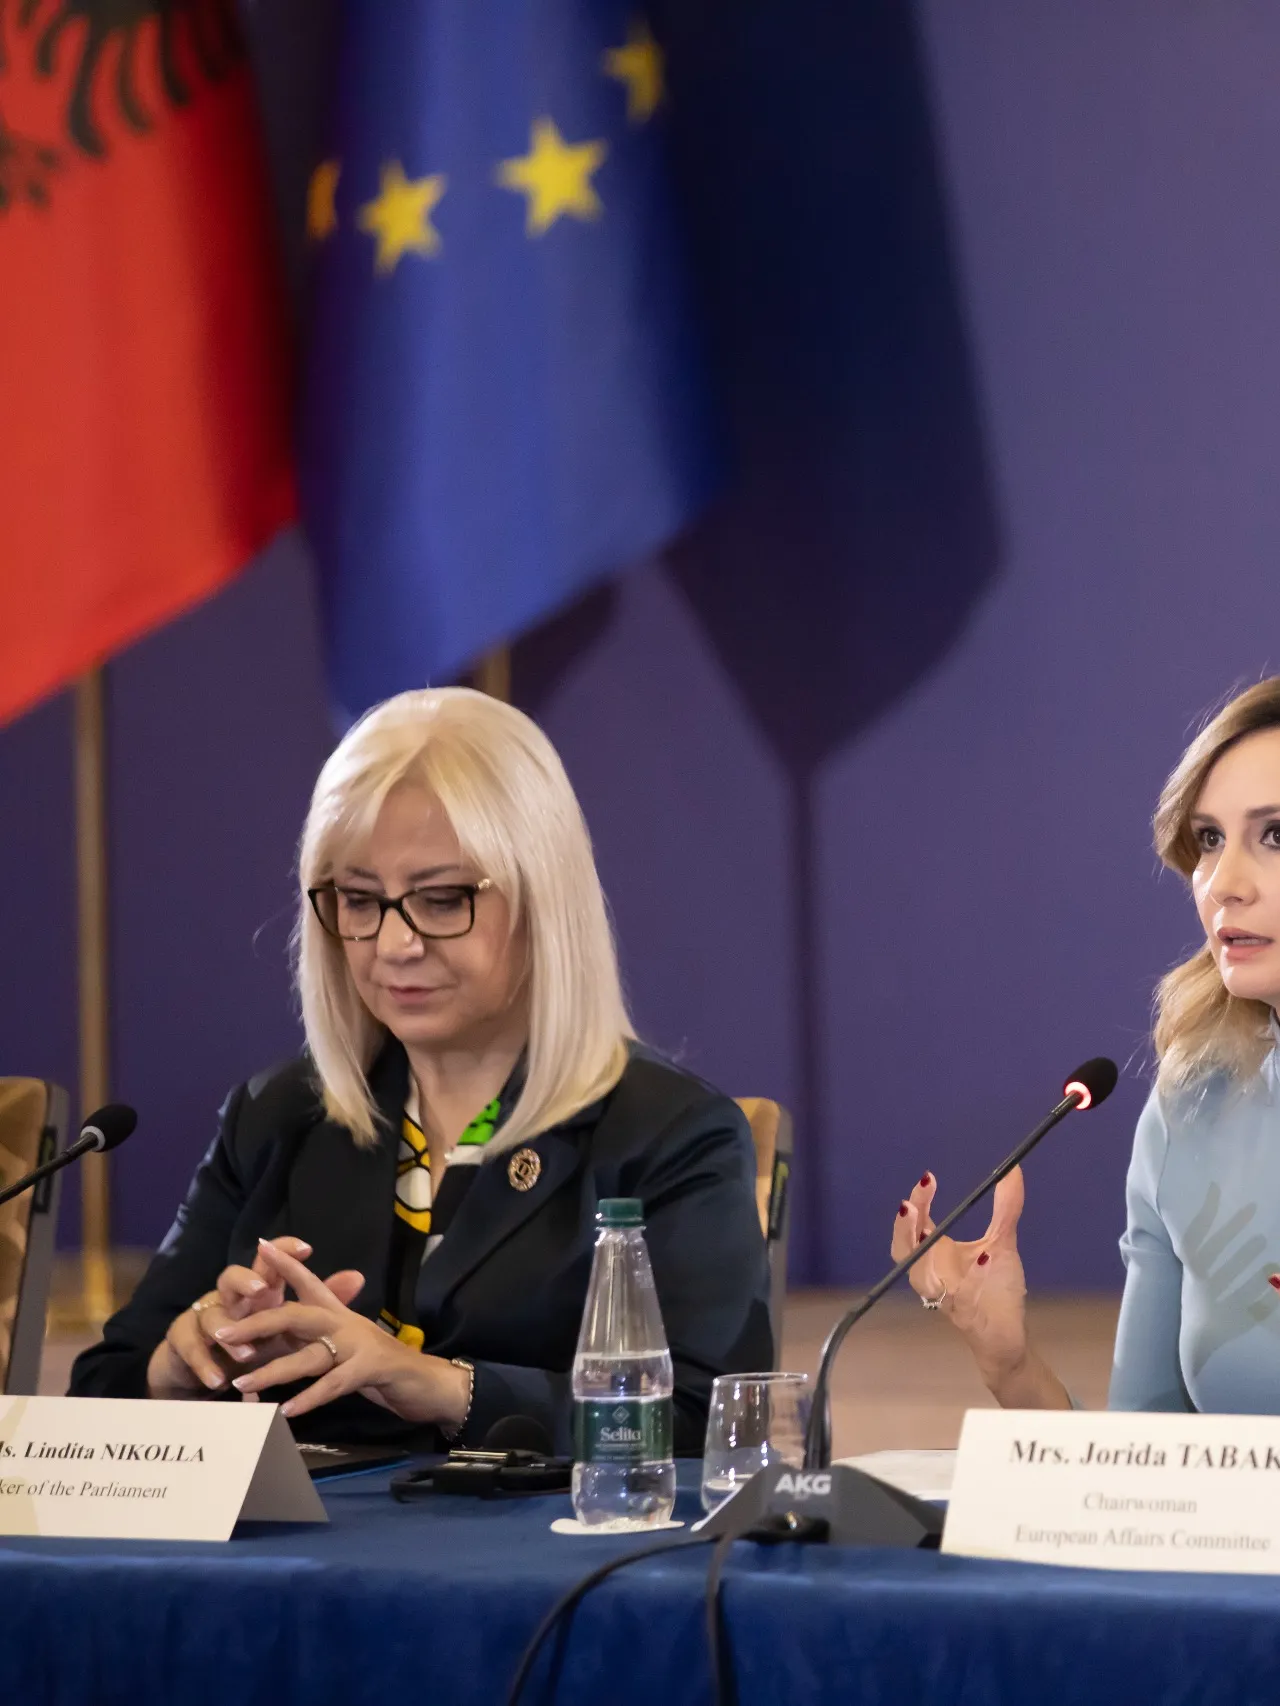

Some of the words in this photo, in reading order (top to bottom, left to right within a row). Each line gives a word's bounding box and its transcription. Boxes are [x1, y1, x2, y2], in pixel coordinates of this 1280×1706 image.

[0, 1440, 17, 1458] s.
[24, 1441, 95, 1460] Lindita
[100, 1443, 205, 1462] NIKOLLA
[1009, 1440, 1070, 1465] Mrs.
[1079, 1442, 1167, 1467] Jorida
[27, 1480, 49, 1496] of
[50, 1481, 75, 1496] the
[80, 1481, 168, 1499] Parliament
[774, 1473, 832, 1495] AKG
[1082, 1492, 1199, 1514] Chairwoman
[1014, 1524, 1099, 1548] European
[1103, 1526, 1166, 1548] Affairs
[1170, 1529, 1272, 1552] Committee
